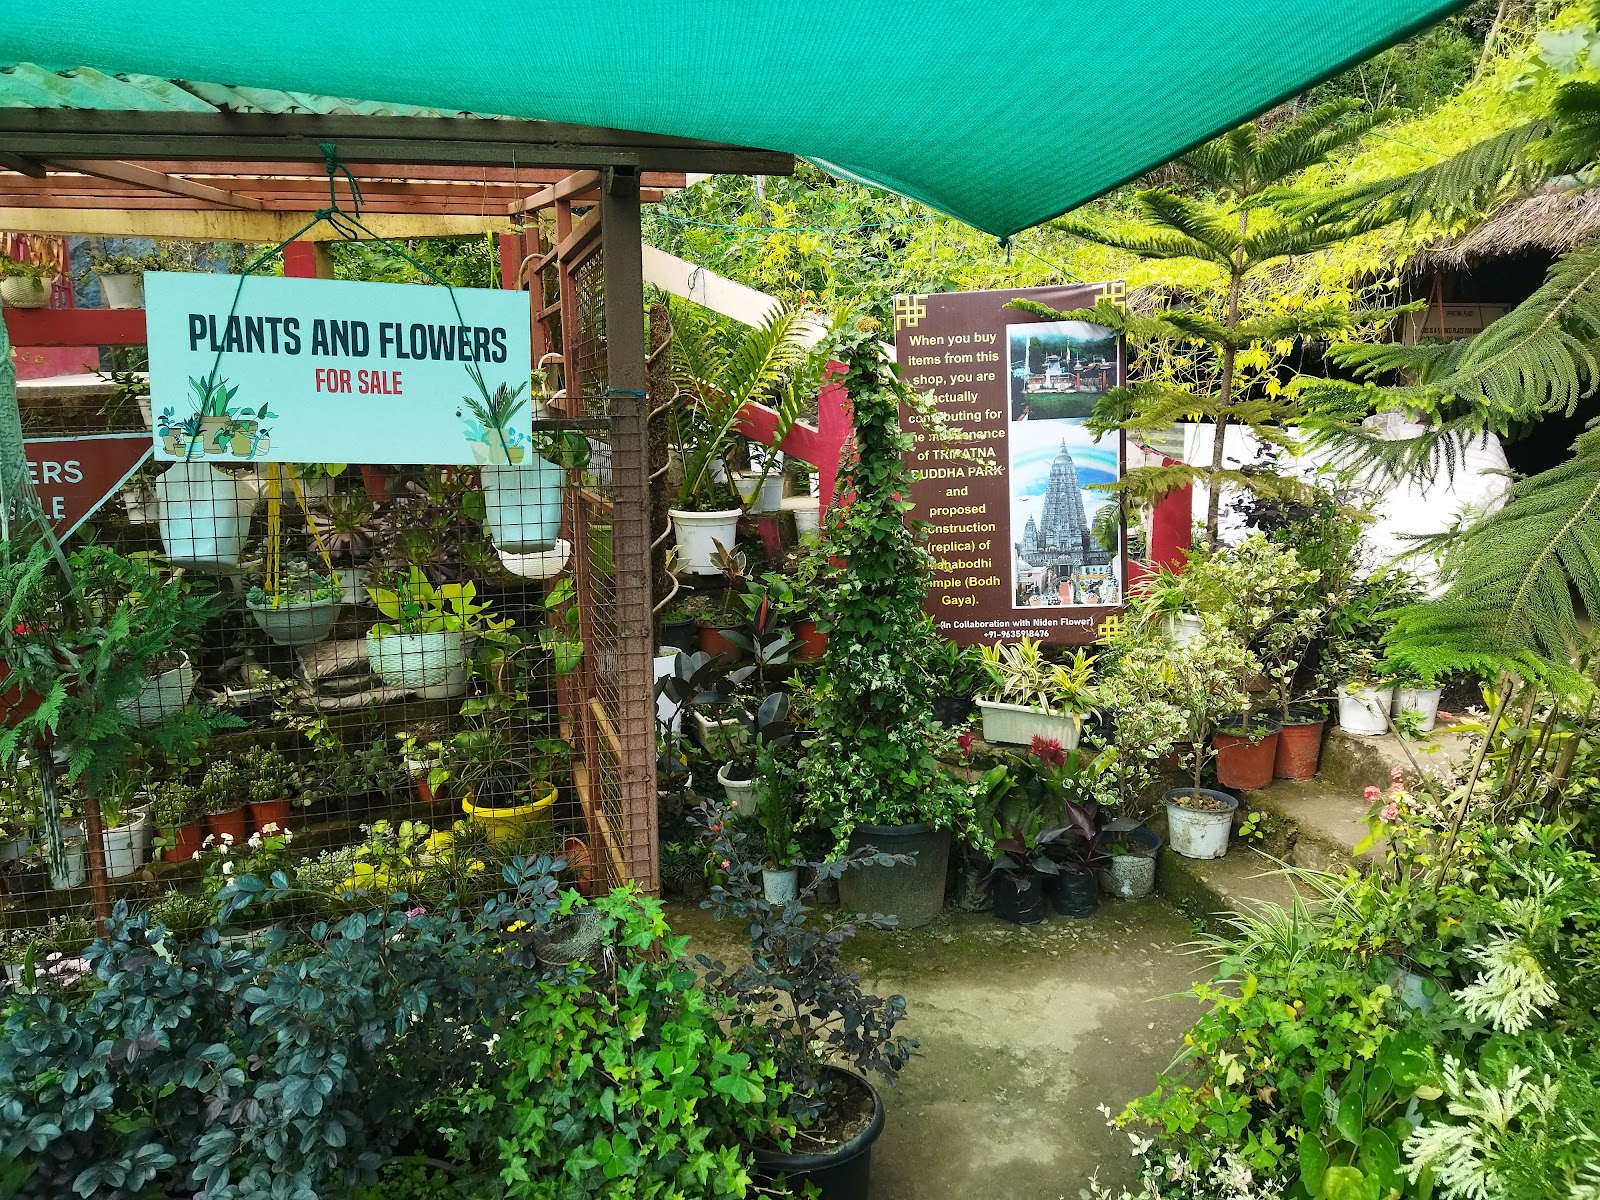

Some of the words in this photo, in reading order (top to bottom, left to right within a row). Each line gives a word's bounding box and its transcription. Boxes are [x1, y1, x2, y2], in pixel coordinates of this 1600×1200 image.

[188, 313, 301, 356] PLANTS
[311, 318, 369, 357] AND
[379, 321, 507, 364] FLOWERS
[909, 334, 944, 347] When
[948, 335, 971, 349] you
[974, 332, 997, 348] buy
[908, 353, 941, 366] items
[944, 352, 973, 364] from
[976, 351, 1000, 362] this
[315, 368, 351, 394] FOR
[358, 369, 403, 395] SALE
[912, 373, 947, 387] shop,
[950, 373, 973, 386] you
[976, 372, 996, 382] are
[984, 408, 1002, 420] for
[917, 450, 930, 461] of
[946, 486, 968, 497] and
[929, 504, 986, 518] proposed
[928, 540, 976, 554] (replica)
[978, 540, 992, 550] of
[964, 576, 1000, 589] (Bodh
[941, 594, 979, 607] Gaya).
[940, 620, 952, 630] (In
[953, 619, 1010, 629] Collaboration
[1012, 618, 1032, 628] with
[1033, 618, 1058, 627] Niden
[1060, 616, 1094, 626] Flower)
